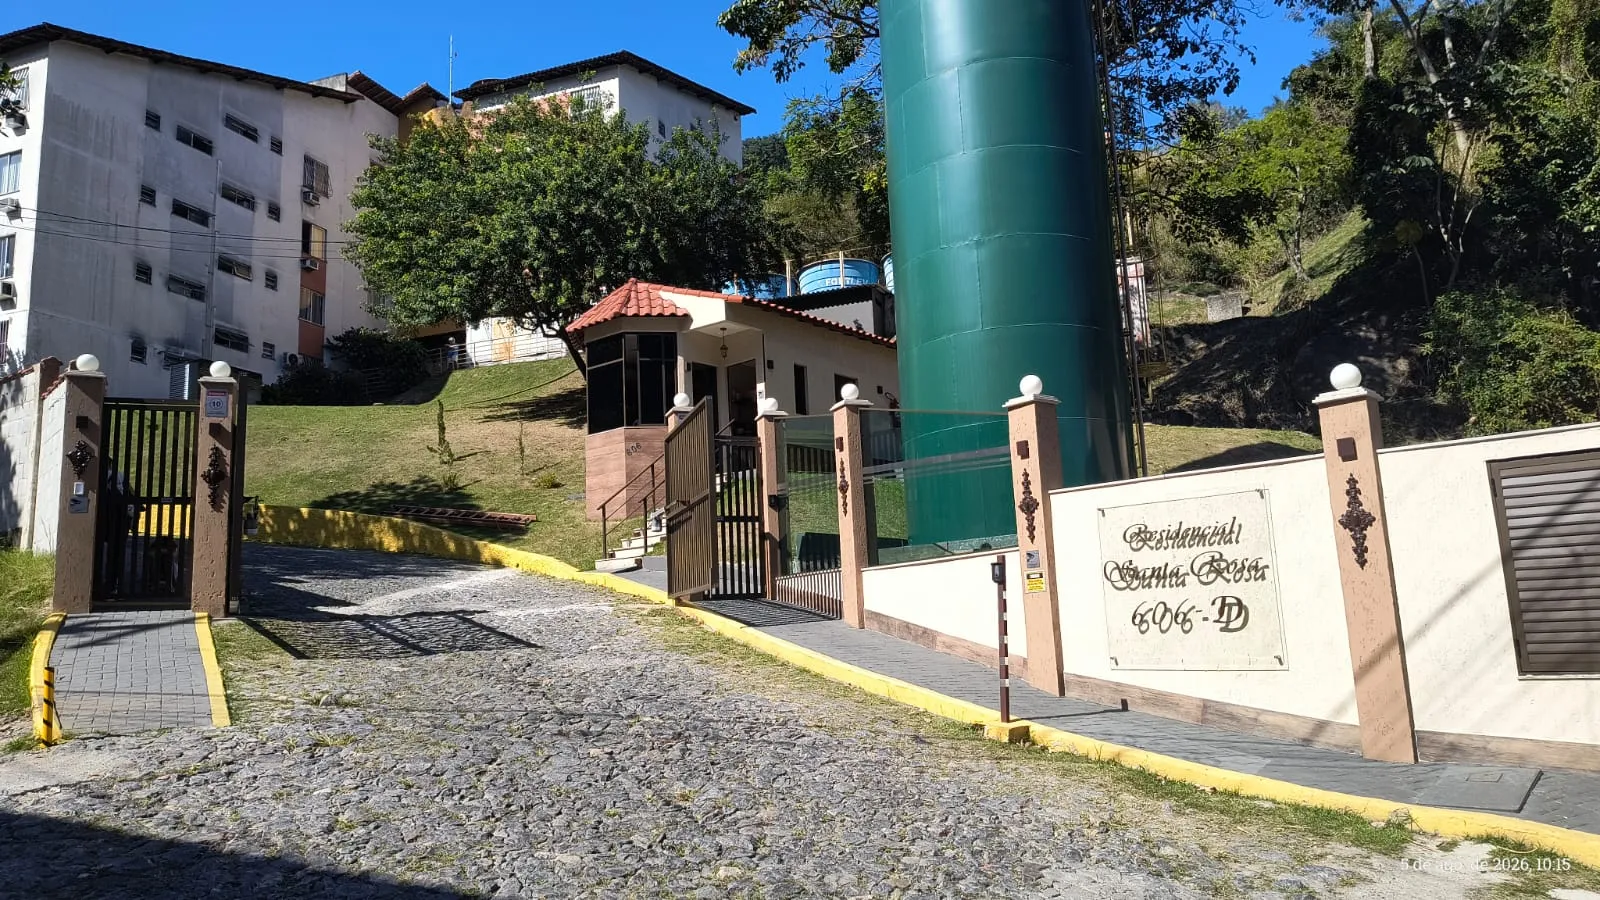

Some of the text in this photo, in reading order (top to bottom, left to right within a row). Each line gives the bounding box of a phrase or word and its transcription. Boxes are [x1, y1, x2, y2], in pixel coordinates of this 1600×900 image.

[626, 442, 641, 456] 606
[1123, 516, 1241, 550] Residencial
[1104, 551, 1268, 590] Santa Rosa
